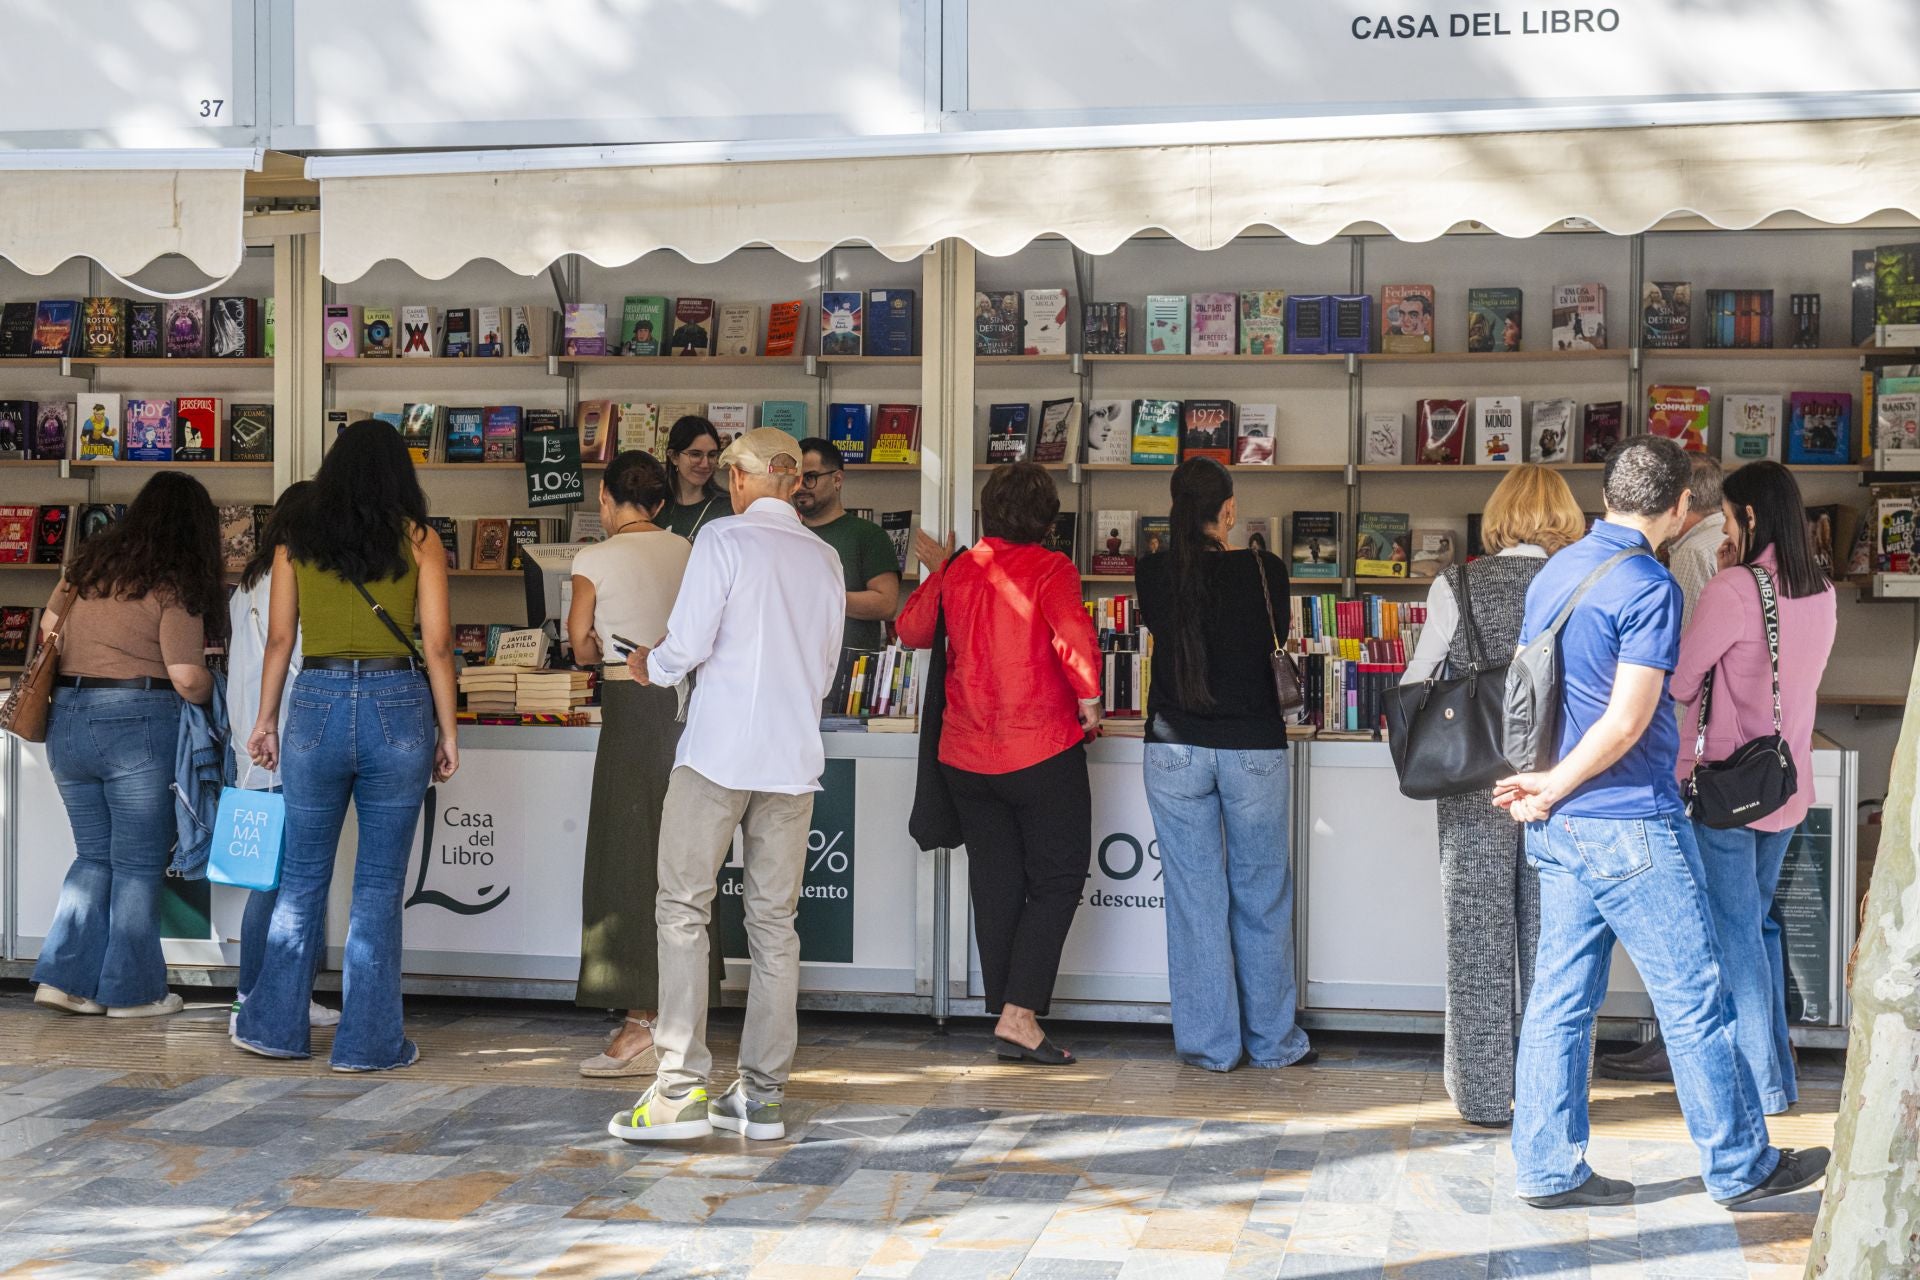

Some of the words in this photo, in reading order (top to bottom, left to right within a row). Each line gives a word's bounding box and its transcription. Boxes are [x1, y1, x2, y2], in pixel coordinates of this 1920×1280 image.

[1351, 15, 1439, 40] CASA
[1450, 13, 1511, 37] DEL
[1522, 8, 1620, 34] LIBRO
[200, 99, 224, 117] 37
[1648, 316, 1687, 325] DESTINO
[89, 334, 114, 345] SOL
[133, 403, 167, 417] HOY
[1654, 403, 1704, 412] COMPARTIR
[1881, 402, 1917, 412] BANKSY
[1192, 408, 1225, 424] 1973
[1485, 414, 1512, 428] MUNDO
[876, 440, 908, 450] ASISTENTA
[530, 471, 580, 492] 10%
[532, 494, 541, 502] de
[542, 491, 581, 501] descuento
[16, 508, 34, 517] HENRY
[1753, 567, 1775, 609] BIMBA
[1766, 609, 1777, 620] Y
[501, 641, 537, 650] CASTILLO
[507, 635, 533, 643] JAVIER
[1767, 623, 1778, 662] LOLA
[500, 652, 535, 660] SUSURRO
[233, 808, 268, 827] FAR
[443, 806, 494, 828] Casa
[233, 825, 261, 842] MA
[468, 830, 494, 846] del
[228, 841, 260, 859] CIA
[442, 844, 494, 866] Libro
[722, 878, 744, 896] de
